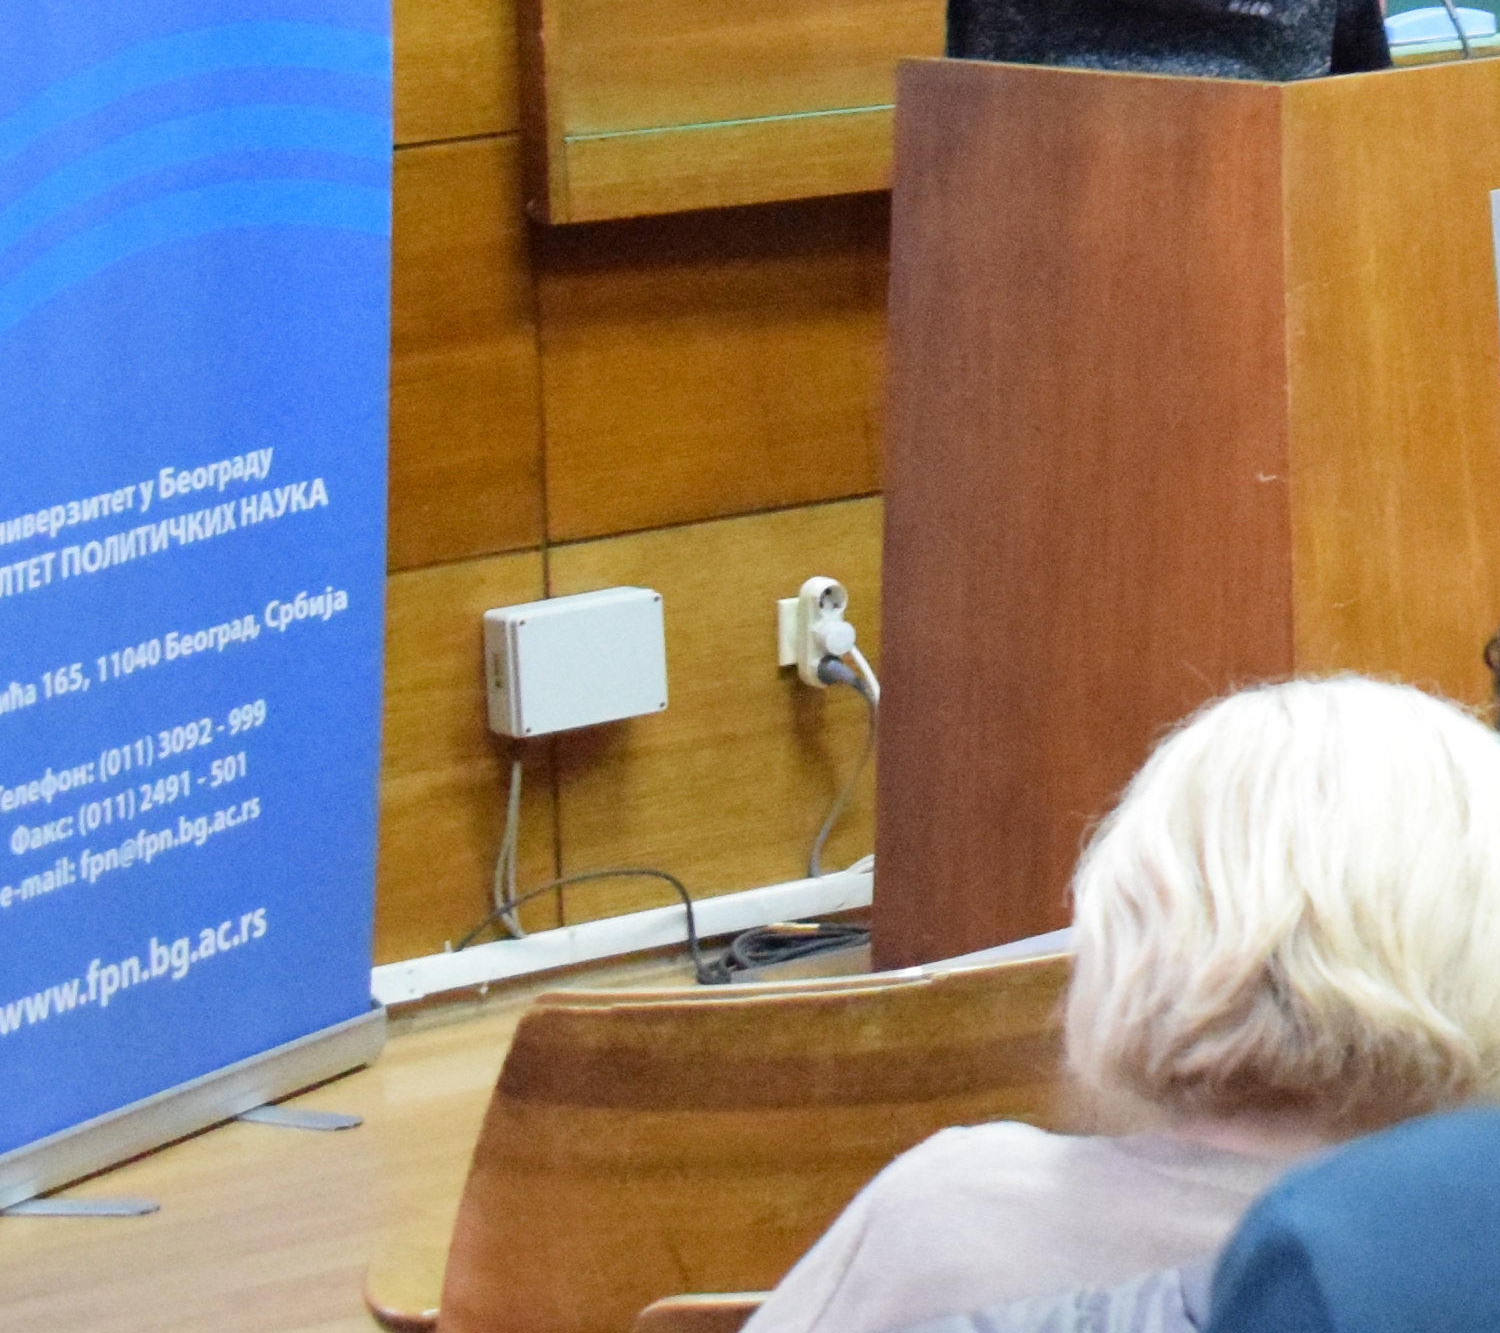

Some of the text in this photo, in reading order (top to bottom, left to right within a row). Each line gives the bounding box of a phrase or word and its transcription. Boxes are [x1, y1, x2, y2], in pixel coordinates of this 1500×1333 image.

[61, 500, 237, 579] ПОЛИТИЧКИХ
[240, 477, 329, 527] НАУКА
[139, 480, 155, 513] у
[159, 447, 274, 499] Београду
[42, 662, 91, 699] 165,
[97, 638, 161, 683] 11040
[264, 585, 348, 632] Србија
[100, 735, 154, 782] (011)
[158, 717, 213, 759] 3092
[228, 698, 267, 735] 999
[0, 796, 261, 908] e-mail: fpn@fpn.bg.ac.rs
[11, 815, 74, 855] Факс:
[78, 788, 136, 836] (011)
[139, 769, 191, 812] 2491
[210, 751, 247, 787] 501
[0, 906, 268, 1035] www.fpn.bg.ac.rs
